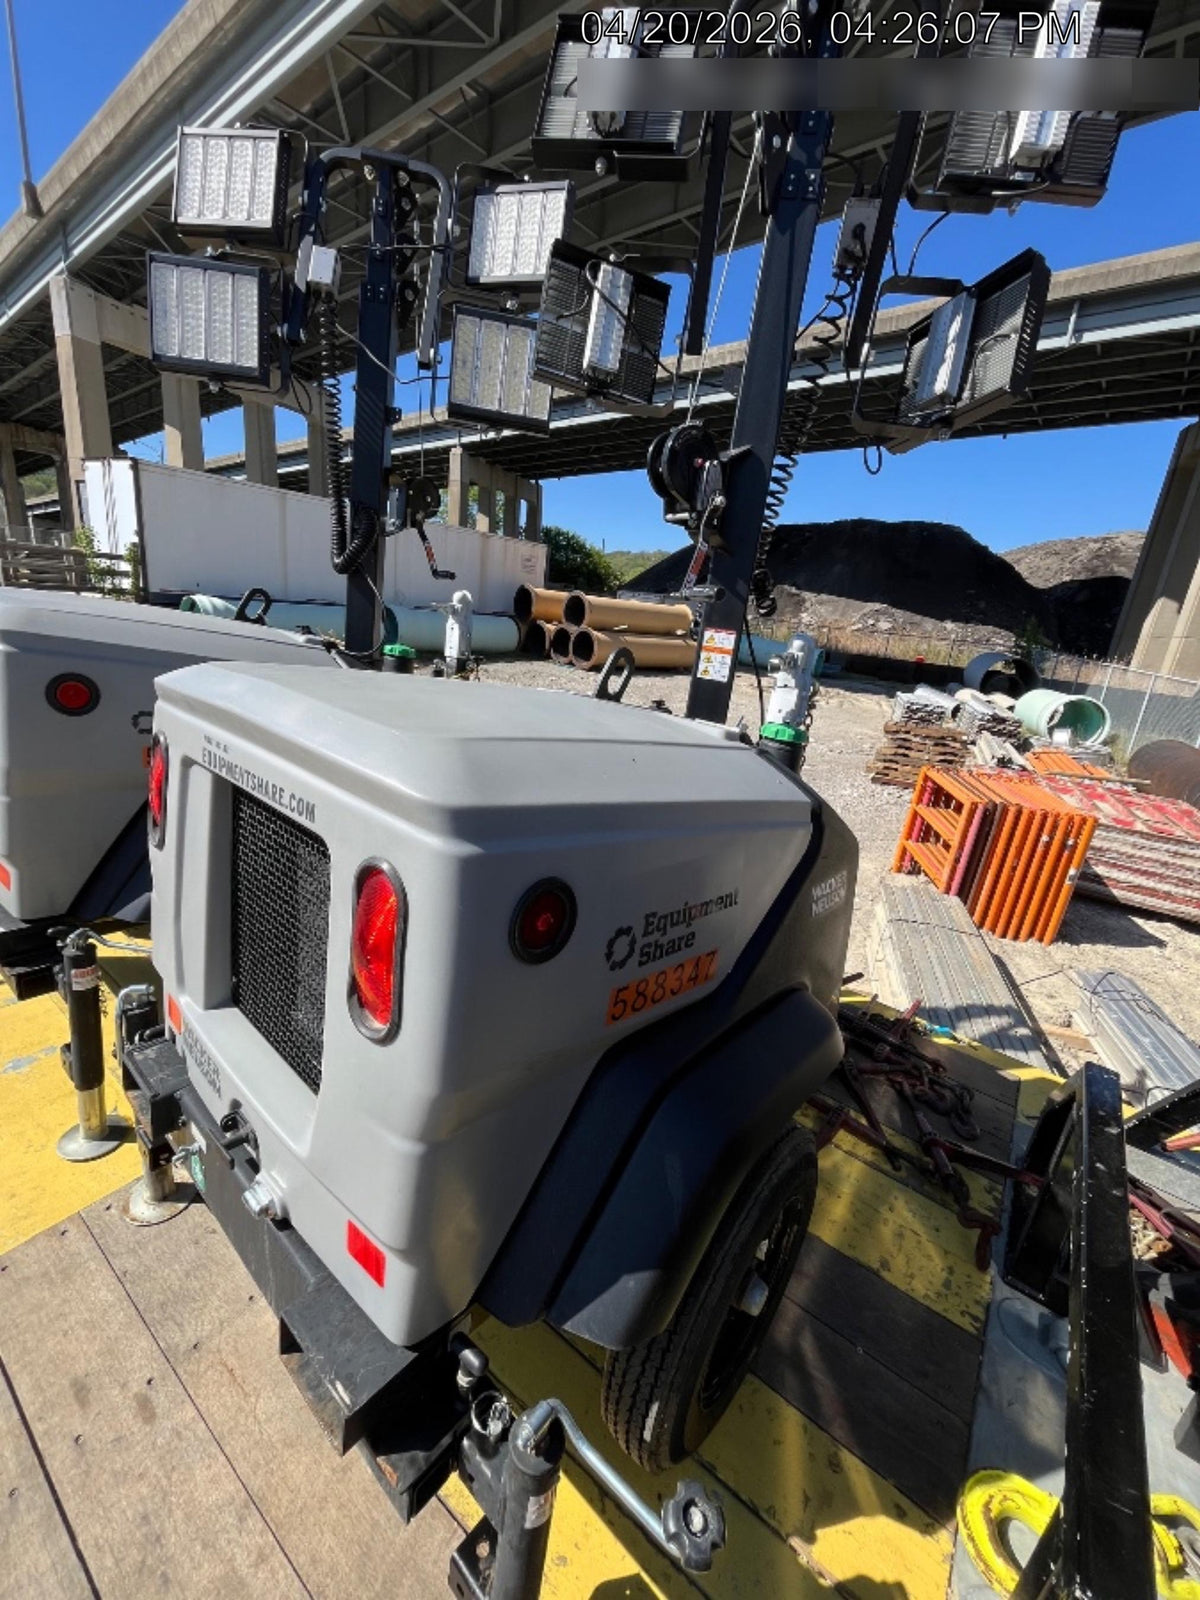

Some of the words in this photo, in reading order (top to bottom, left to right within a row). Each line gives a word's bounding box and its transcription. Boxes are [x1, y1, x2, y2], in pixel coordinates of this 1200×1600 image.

[202, 747, 316, 823] EQUIPMENTSHARE.COM
[641, 886, 740, 938] Equipment
[638, 930, 697, 967] Share
[610, 949, 718, 1022] 588347
